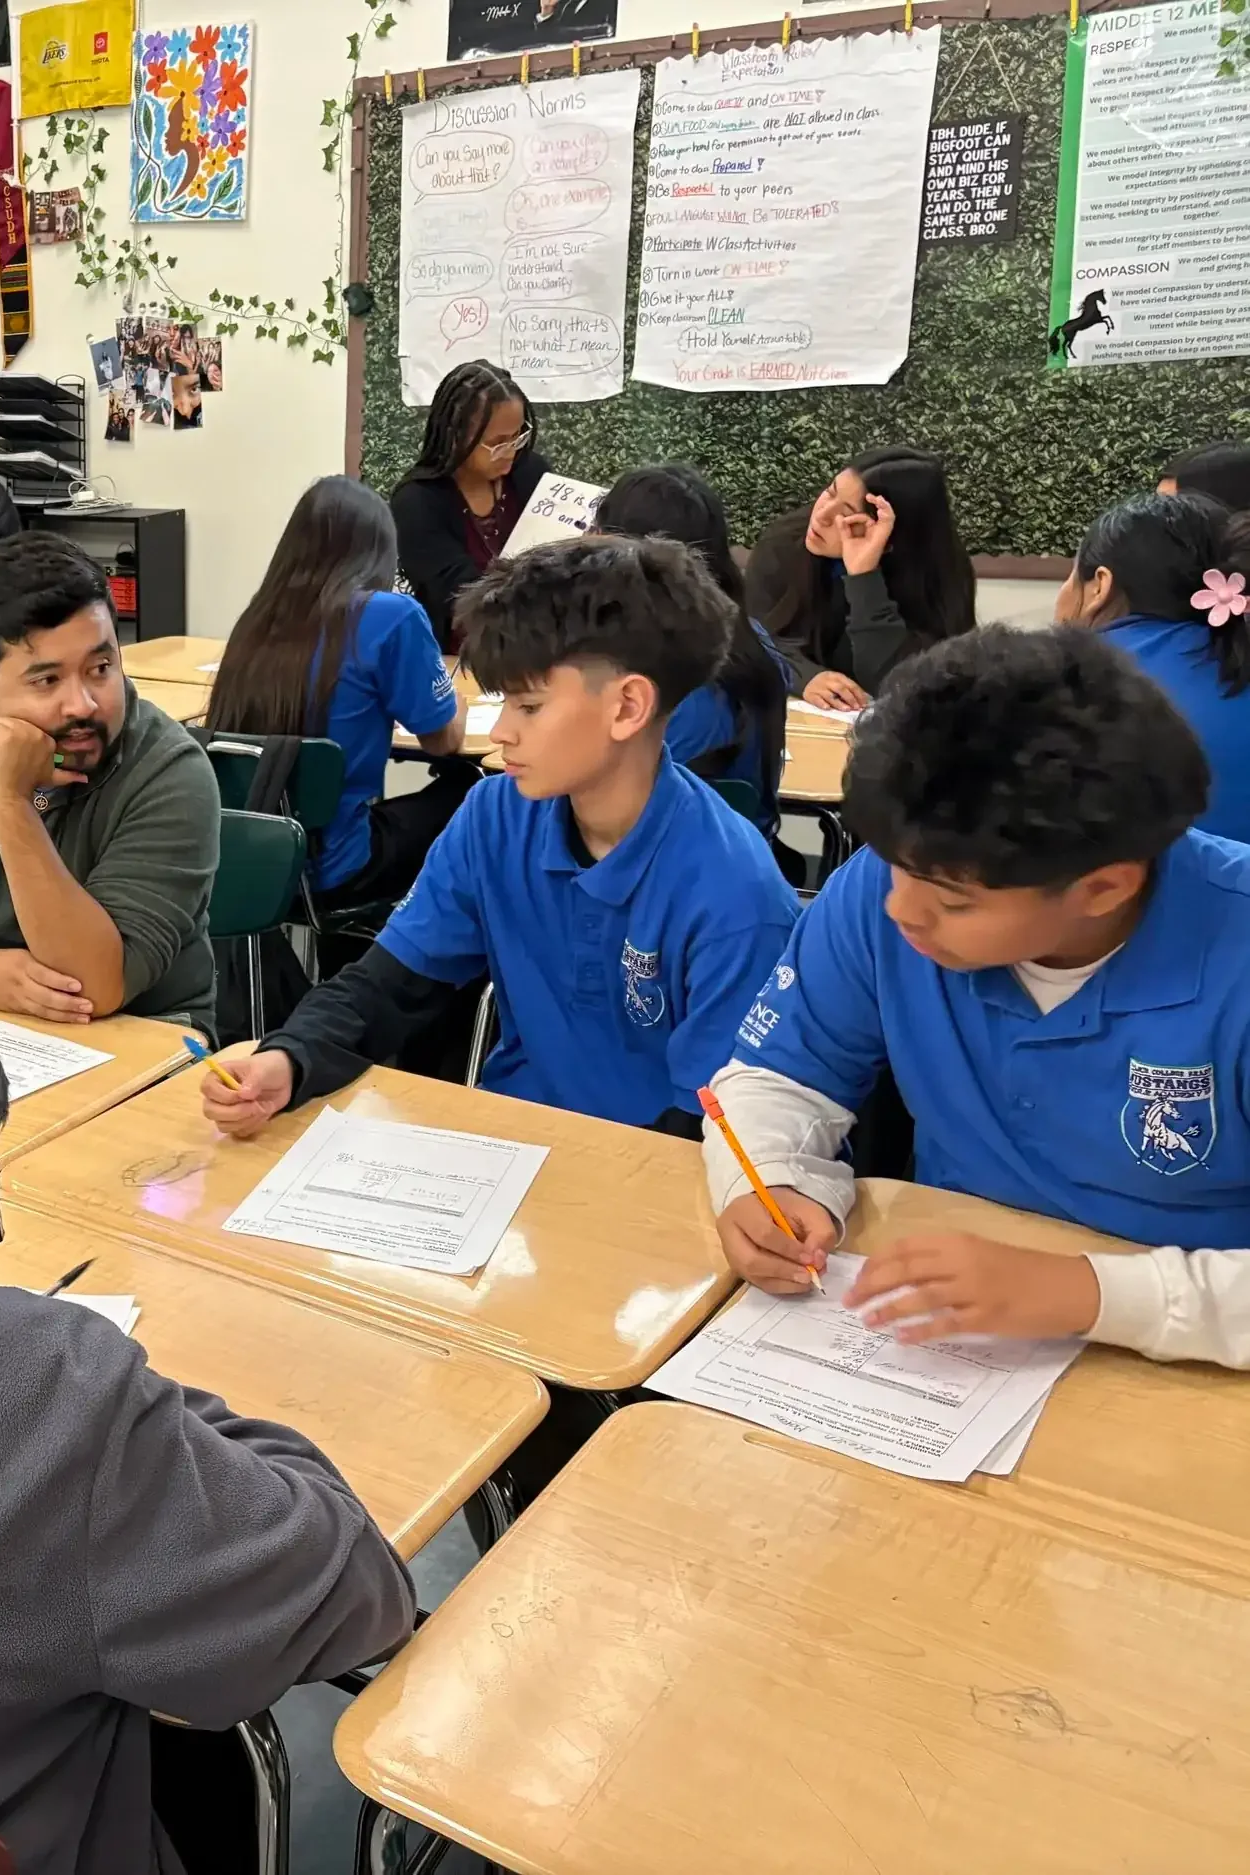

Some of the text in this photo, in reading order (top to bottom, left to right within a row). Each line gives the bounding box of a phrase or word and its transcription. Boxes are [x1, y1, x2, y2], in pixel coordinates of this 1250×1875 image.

[1168, 7, 1183, 21] 12
[1091, 36, 1150, 55] RESPECT
[747, 96, 768, 108] and
[427, 91, 586, 134] Discussion Norms
[763, 118, 780, 130] are
[784, 112, 806, 127] NOT
[844, 111, 854, 121] in
[996, 121, 1008, 133] IF
[712, 136, 726, 150] for
[728, 135, 768, 150] permission
[817, 131, 834, 145] your
[930, 134, 1011, 153] BIGFOOT CAN
[416, 143, 438, 169] Can
[443, 149, 460, 172] you
[486, 144, 510, 155] more
[929, 148, 1000, 165] STAY QUIET
[679, 167, 691, 176] to
[928, 159, 1009, 178] AND MIND HIS
[431, 170, 464, 188] about
[927, 173, 1006, 190] OWN BIZ FOR
[655, 185, 670, 197] Be
[720, 185, 730, 196] to
[733, 186, 759, 201] your
[762, 184, 793, 196] peers
[971, 186, 1000, 198] THEN
[1004, 184, 1012, 195] U
[3, 185, 16, 244] CSUDH
[925, 198, 998, 215] CAN DO THE
[924, 209, 1008, 228] SAME FOR ONE
[969, 223, 998, 236] BRO.
[1099, 237, 1123, 246] model
[1125, 232, 1161, 244] Integrity
[1163, 231, 1172, 239] by
[1174, 225, 1224, 238] consistently
[541, 244, 560, 259] not
[1151, 243, 1171, 251] staff
[1172, 239, 1210, 249] members
[508, 263, 564, 276] understand
[653, 267, 720, 282] Turn in work
[1076, 261, 1170, 280] COMPASSION
[650, 295, 672, 306] Give
[686, 295, 704, 309] your
[1169, 292, 1221, 303] backgrounds
[453, 301, 483, 331] Yes!
[509, 315, 526, 333] No
[649, 307, 745, 325] Keep CLEAN
[509, 338, 531, 351] not
[533, 336, 566, 352] what
[687, 332, 717, 348] Hold
[509, 356, 554, 368] I mean
[673, 360, 700, 381] Your
[749, 363, 795, 380] EARNED
[550, 483, 585, 506] 48 is
[531, 498, 554, 516] 80
